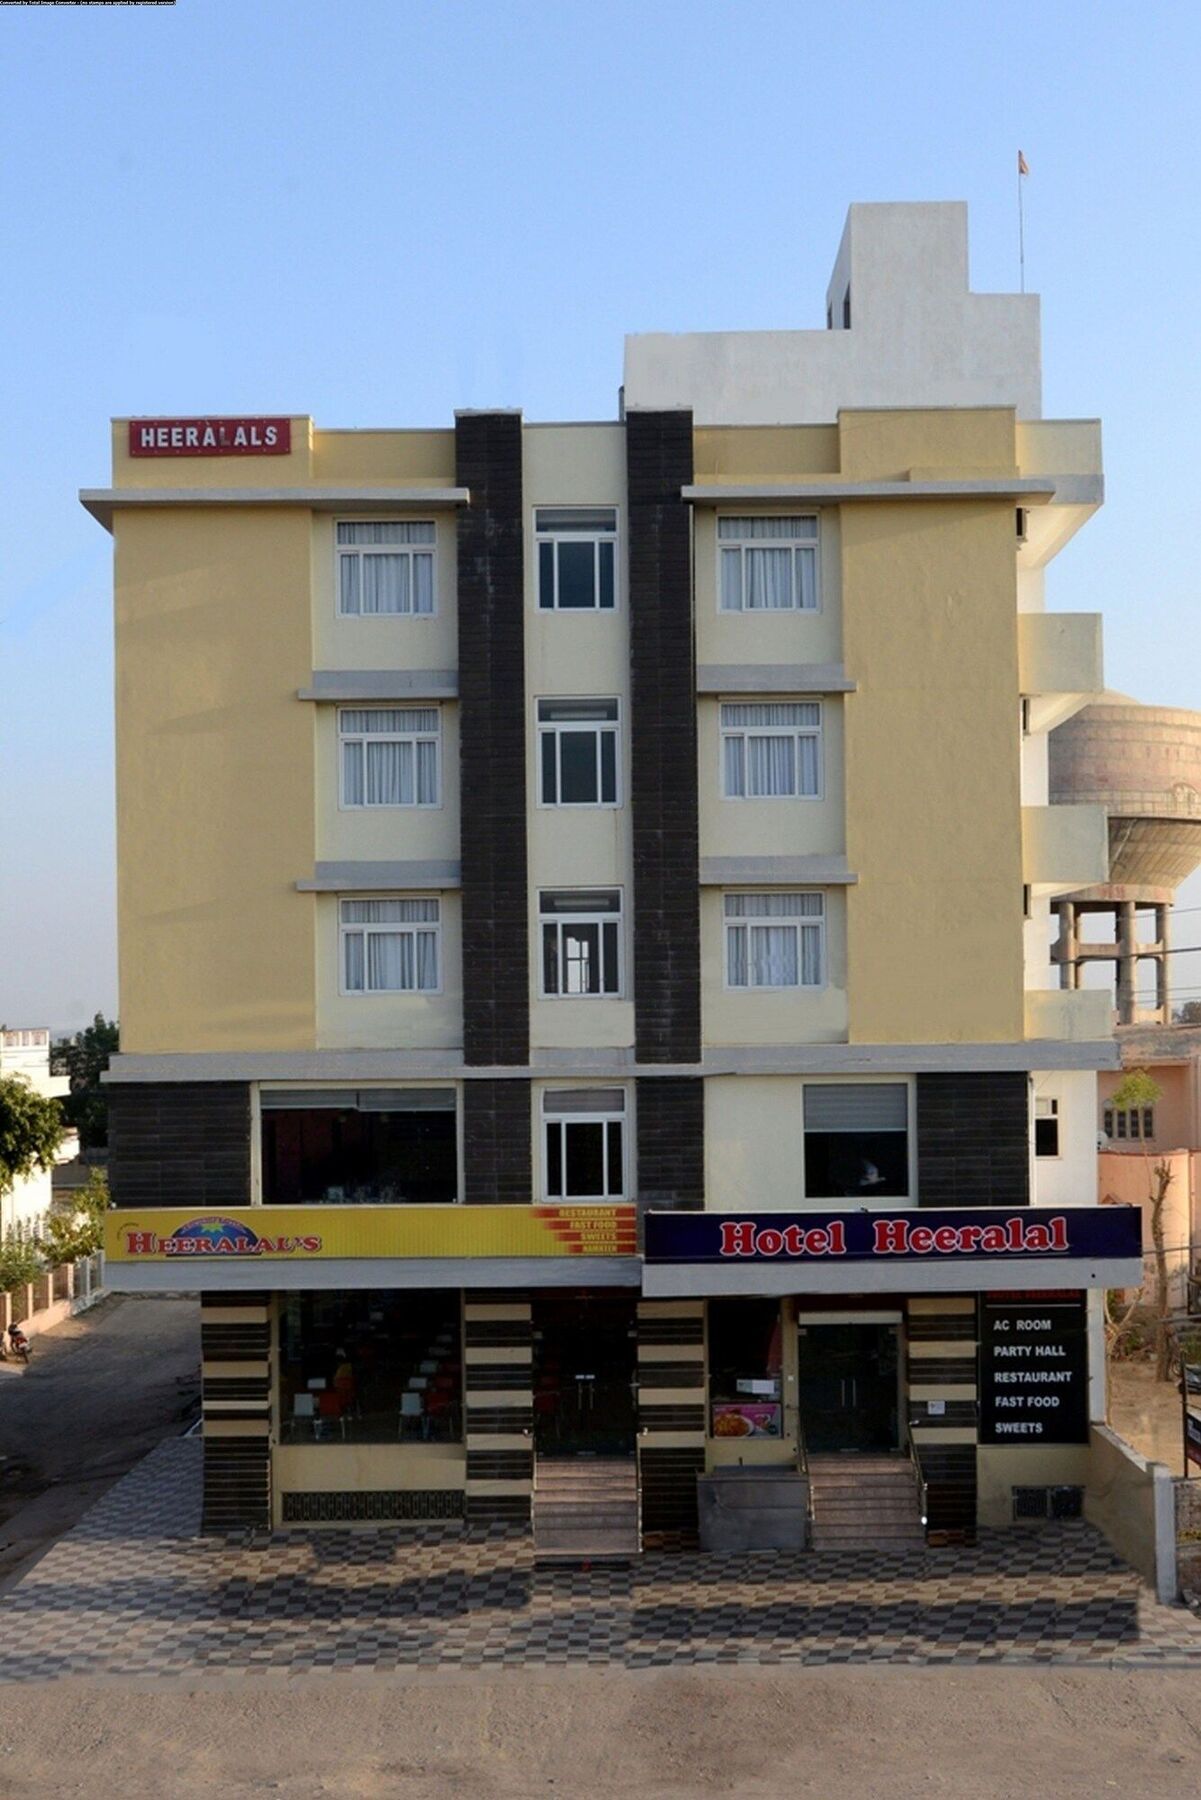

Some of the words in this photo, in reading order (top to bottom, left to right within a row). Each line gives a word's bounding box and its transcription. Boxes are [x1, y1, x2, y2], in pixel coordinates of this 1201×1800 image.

[559, 1209, 616, 1217] RESTAURANT
[570, 1221, 591, 1229] FAST
[593, 1221, 617, 1229] FOOD
[581, 1233, 617, 1241] SWEETS
[720, 1221, 846, 1255] Hotel
[872, 1217, 1069, 1254] Heeralal
[126, 1231, 322, 1255] HEERALAL'S
[993, 1320, 1010, 1331] AC
[1016, 1320, 1052, 1331] ROOM
[993, 1346, 1032, 1357] PARTY
[1035, 1346, 1066, 1356] HALL
[994, 1371, 1072, 1383] RESTAURANT
[995, 1396, 1025, 1408] FAST
[1027, 1396, 1060, 1408] FOOD
[995, 1422, 1043, 1433] SWEETS
